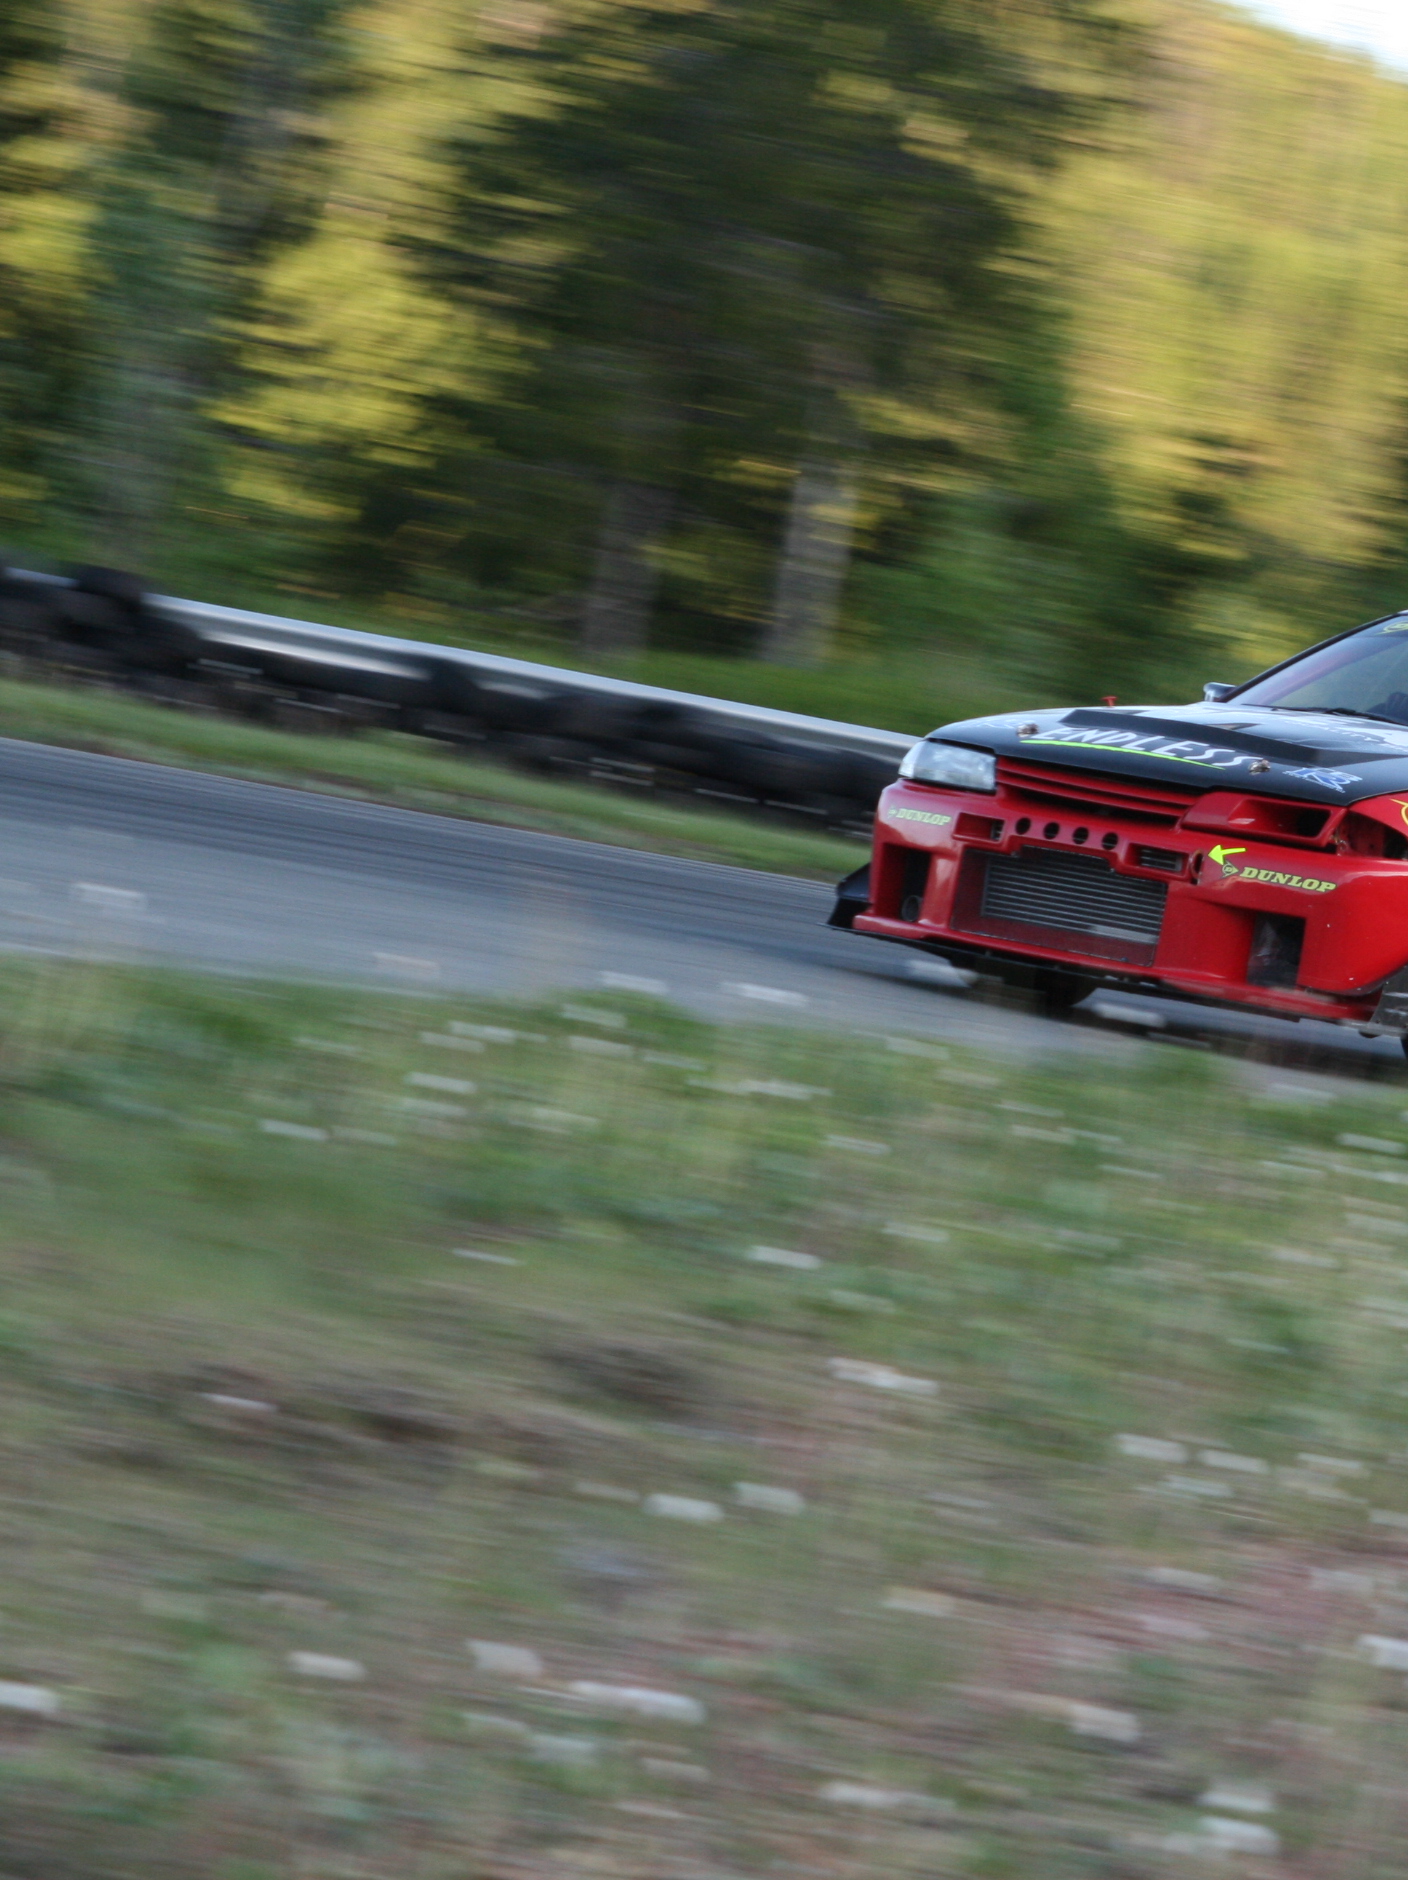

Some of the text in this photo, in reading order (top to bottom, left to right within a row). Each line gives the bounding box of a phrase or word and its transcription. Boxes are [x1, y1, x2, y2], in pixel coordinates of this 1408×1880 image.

[1032, 728, 1264, 767] ENDLESS
[896, 808, 951, 826] DUNLOP
[1240, 866, 1336, 892] DUNLOP
